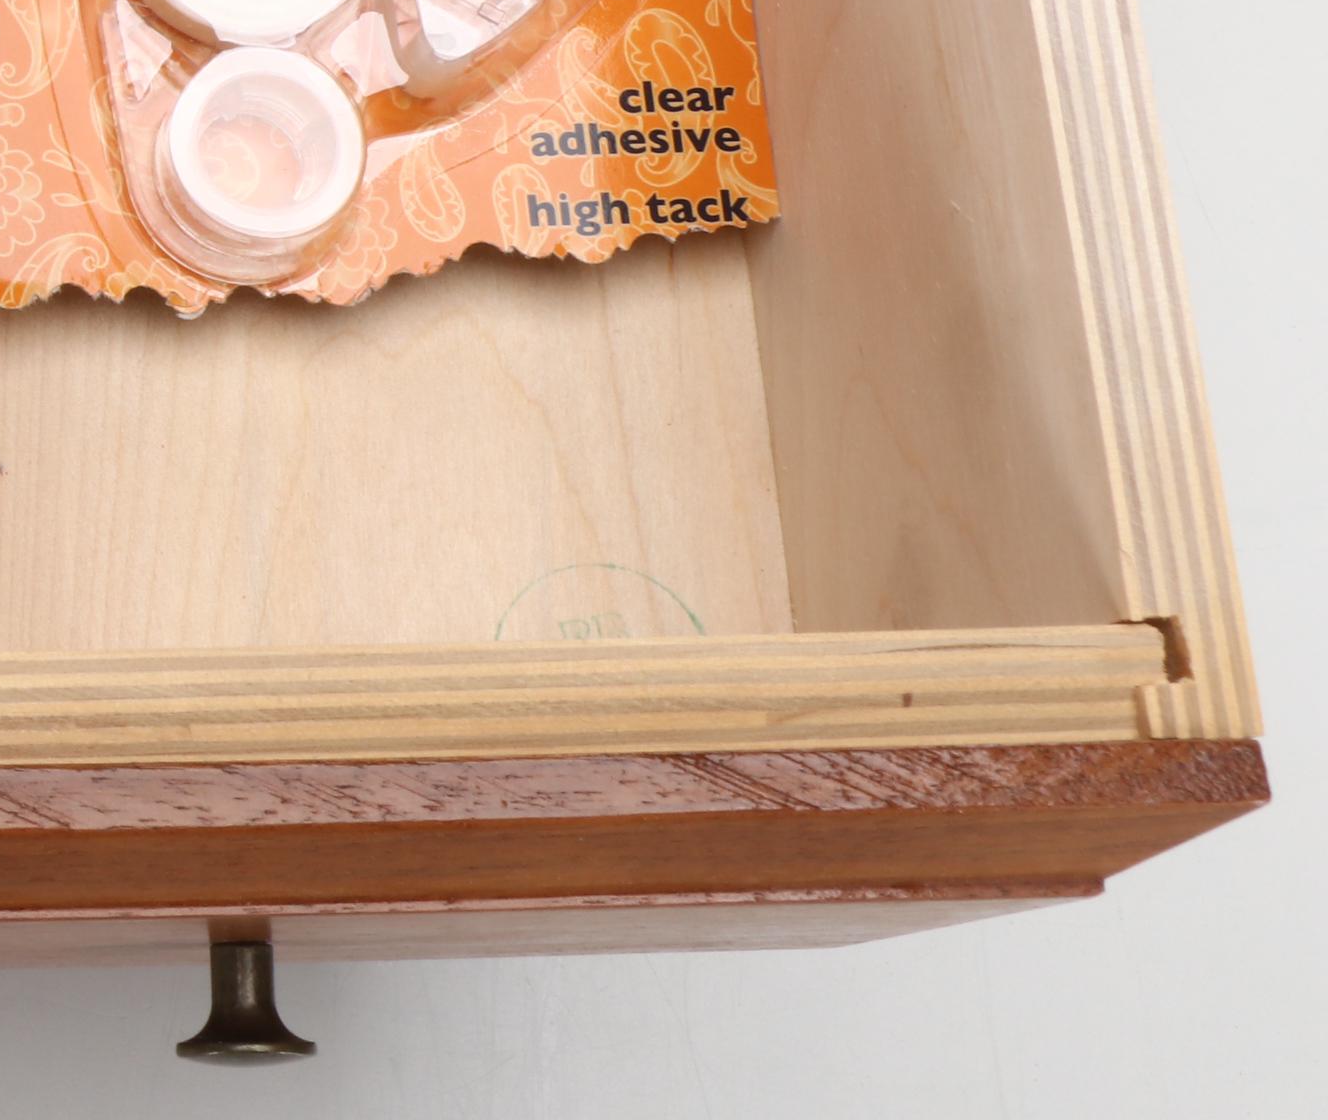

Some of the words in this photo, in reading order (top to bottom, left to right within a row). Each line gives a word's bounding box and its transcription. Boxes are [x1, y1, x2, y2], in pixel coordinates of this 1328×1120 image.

[619, 81, 734, 113] clear
[531, 121, 741, 156] adhesive
[528, 192, 630, 236] high
[646, 189, 749, 223] tack
